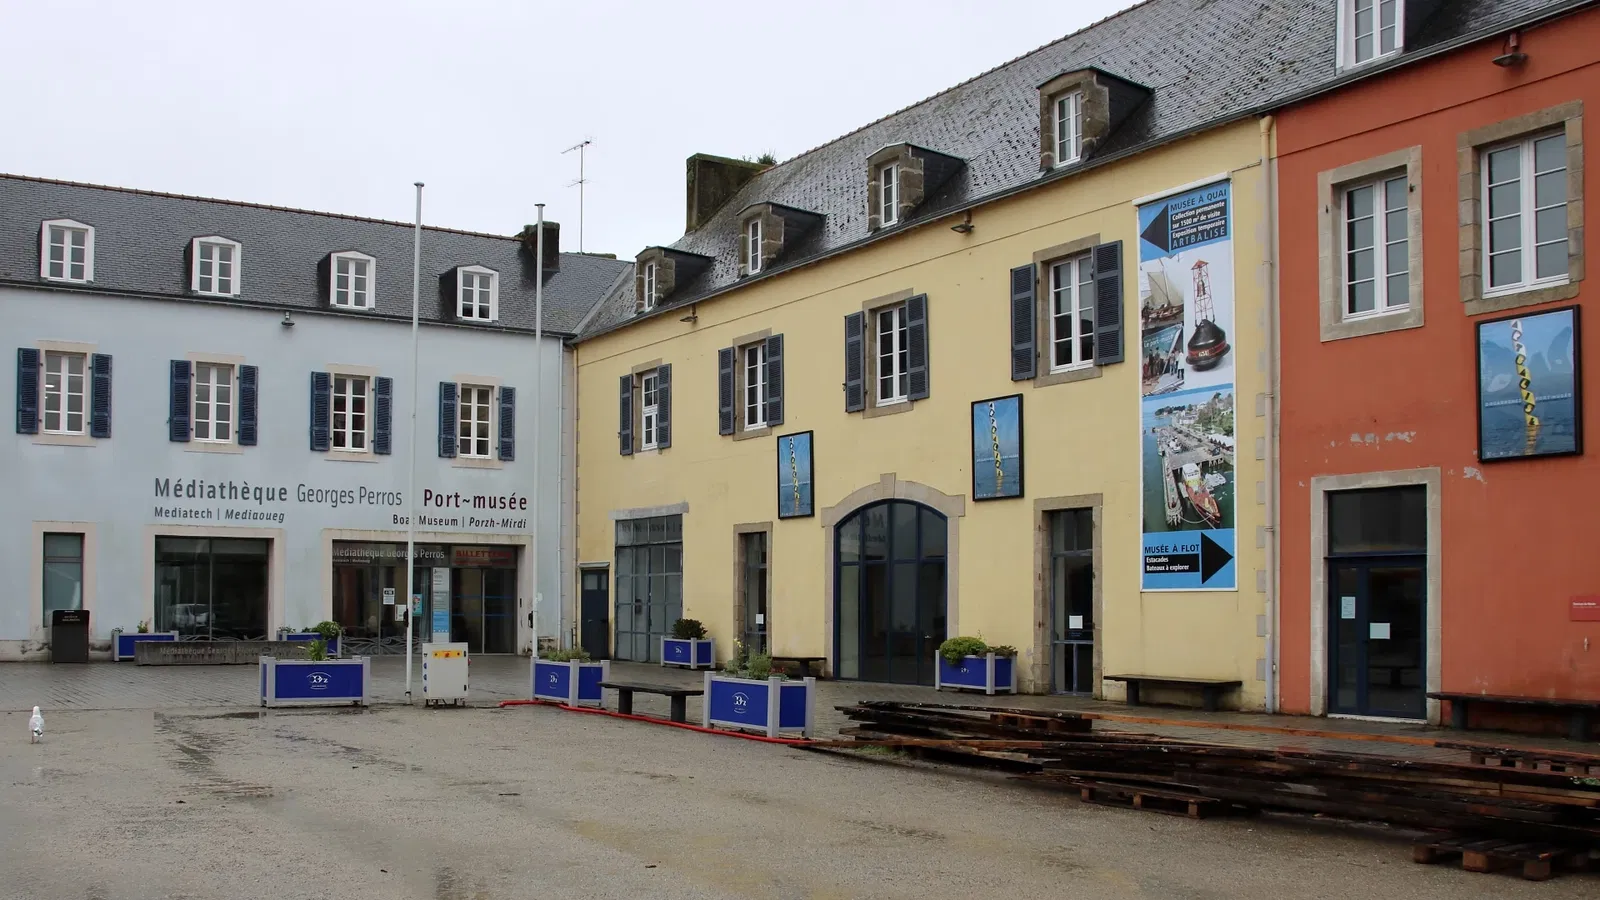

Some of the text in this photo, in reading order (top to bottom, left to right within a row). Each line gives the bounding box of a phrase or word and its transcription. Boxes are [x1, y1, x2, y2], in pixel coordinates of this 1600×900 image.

[1171, 198, 1195, 212] MUSÉE
[1207, 189, 1227, 201] QUAI
[1172, 201, 1225, 221] Collection permanente
[1181, 217, 1193, 226] 1500
[1200, 213, 1207, 221] de
[1208, 210, 1221, 219] visite
[1172, 219, 1225, 239] Exposition temporaire
[155, 477, 288, 505] Médiathèque
[297, 483, 354, 508] Georges
[359, 486, 403, 506] Perros
[154, 506, 285, 523] Mediatech Mediaoueg
[393, 514, 527, 529] Boa Museum Porzh-Mirdi
[386, 549, 418, 560] Georgs
[420, 548, 445, 559] Perros
[1145, 544, 1199, 554] MUSÉE À FLOT
[1170, 564, 1190, 572] explorer
